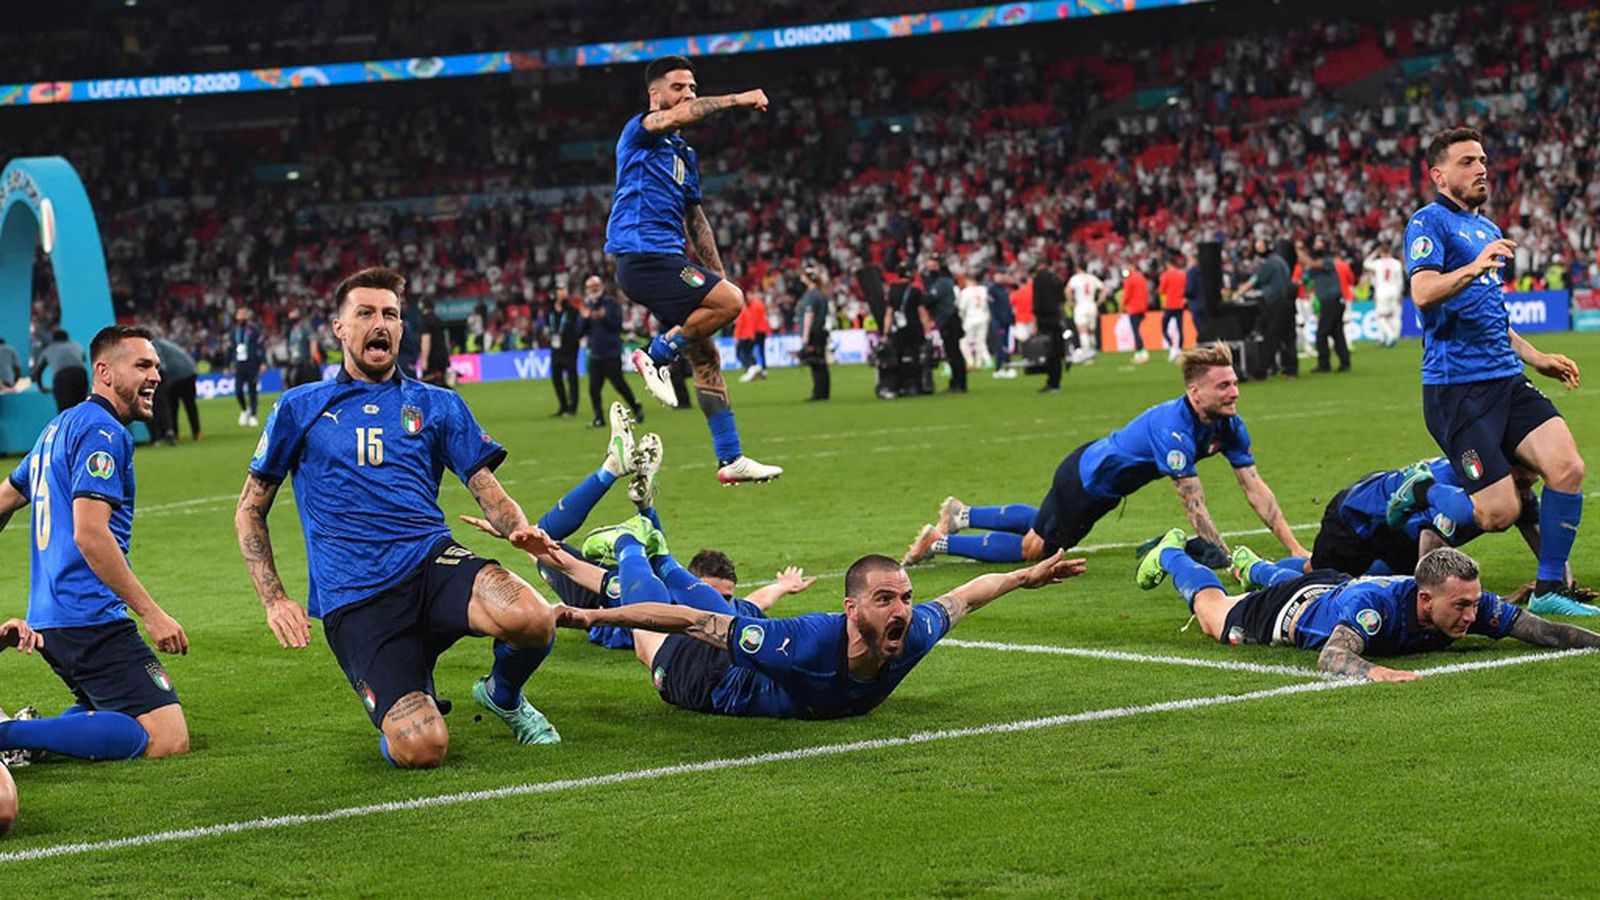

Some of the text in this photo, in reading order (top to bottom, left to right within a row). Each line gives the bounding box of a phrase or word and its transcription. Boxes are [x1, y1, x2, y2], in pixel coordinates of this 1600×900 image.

[774, 23, 850, 47] LONDON
[87, 73, 240, 98] UEFA EURO 2020
[513, 350, 551, 379] viv
[356, 428, 384, 466] 15
